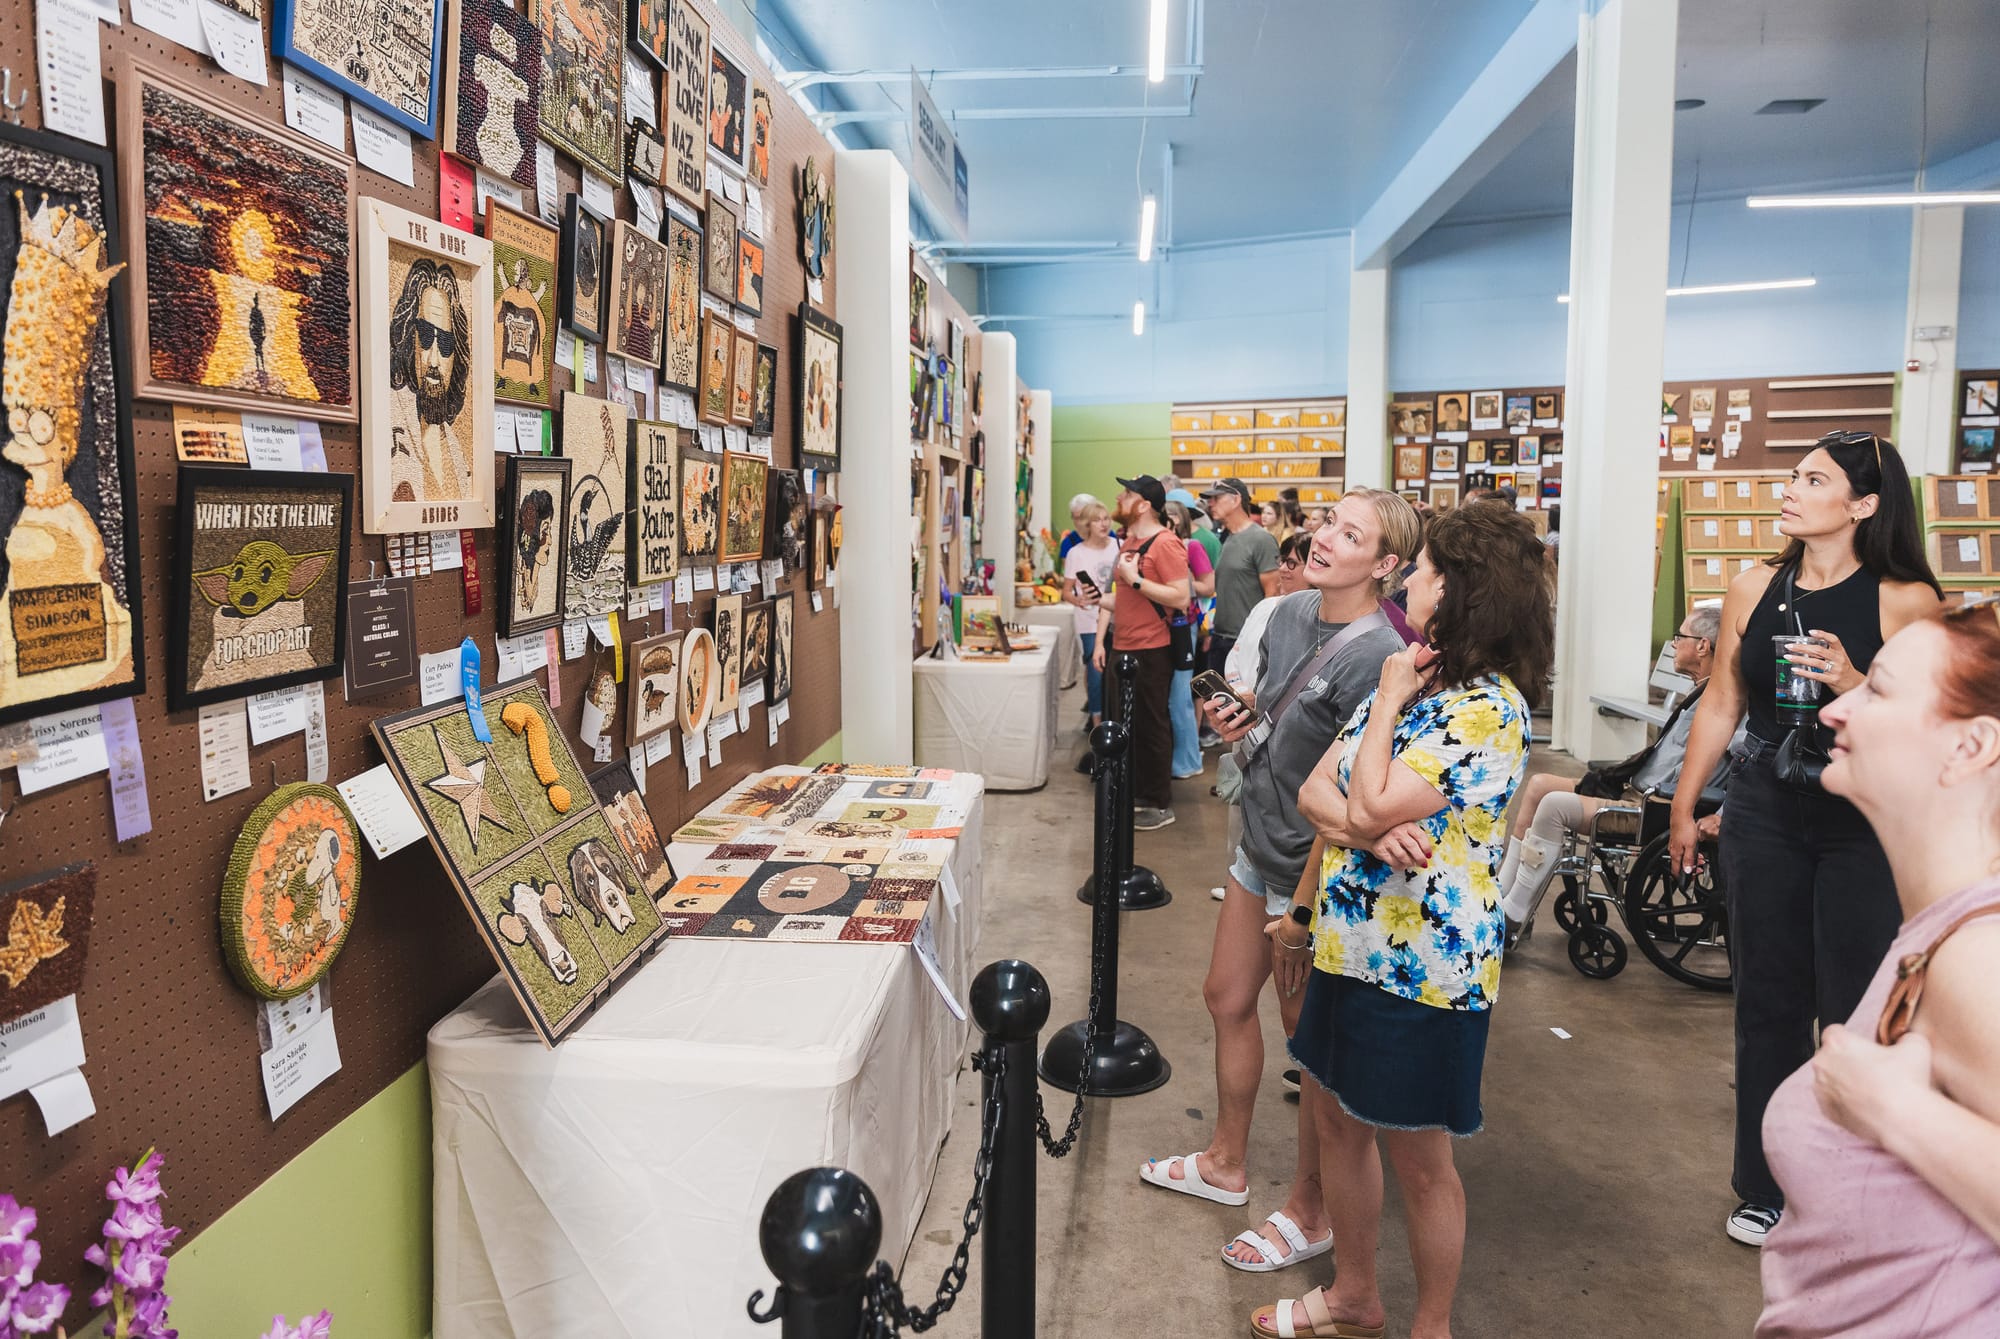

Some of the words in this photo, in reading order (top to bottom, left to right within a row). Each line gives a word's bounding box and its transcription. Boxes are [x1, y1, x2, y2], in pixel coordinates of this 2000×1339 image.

[671, 2, 702, 63] HONK
[347, 59, 370, 83] JOY
[671, 44, 683, 75] IF
[687, 54, 705, 97] YOU
[676, 79, 703, 127] LOVE
[672, 121, 694, 161] NAZ
[677, 159, 701, 194] REID
[407, 220, 428, 244] THE
[440, 231, 467, 257] DUDE
[251, 423, 270, 435] Lucas
[271, 424, 296, 436] Roberts
[644, 464, 671, 502] glad
[195, 502, 241, 530] WHEN
[244, 503, 252, 529] I
[252, 503, 279, 529] SEE
[281, 503, 305, 528] THE
[307, 503, 336, 527] LINE
[421, 506, 459, 524] ABIDES
[25, 608, 91, 631] SIMPSON
[215, 637, 245, 666] FOR
[245, 628, 286, 658] CROP
[287, 626, 313, 652] ART
[363, 633, 382, 642] NATURAL
[60, 713, 103, 731] Sorensen
[271, 1056, 286, 1072] Sara
[287, 1041, 307, 1063] Shields
